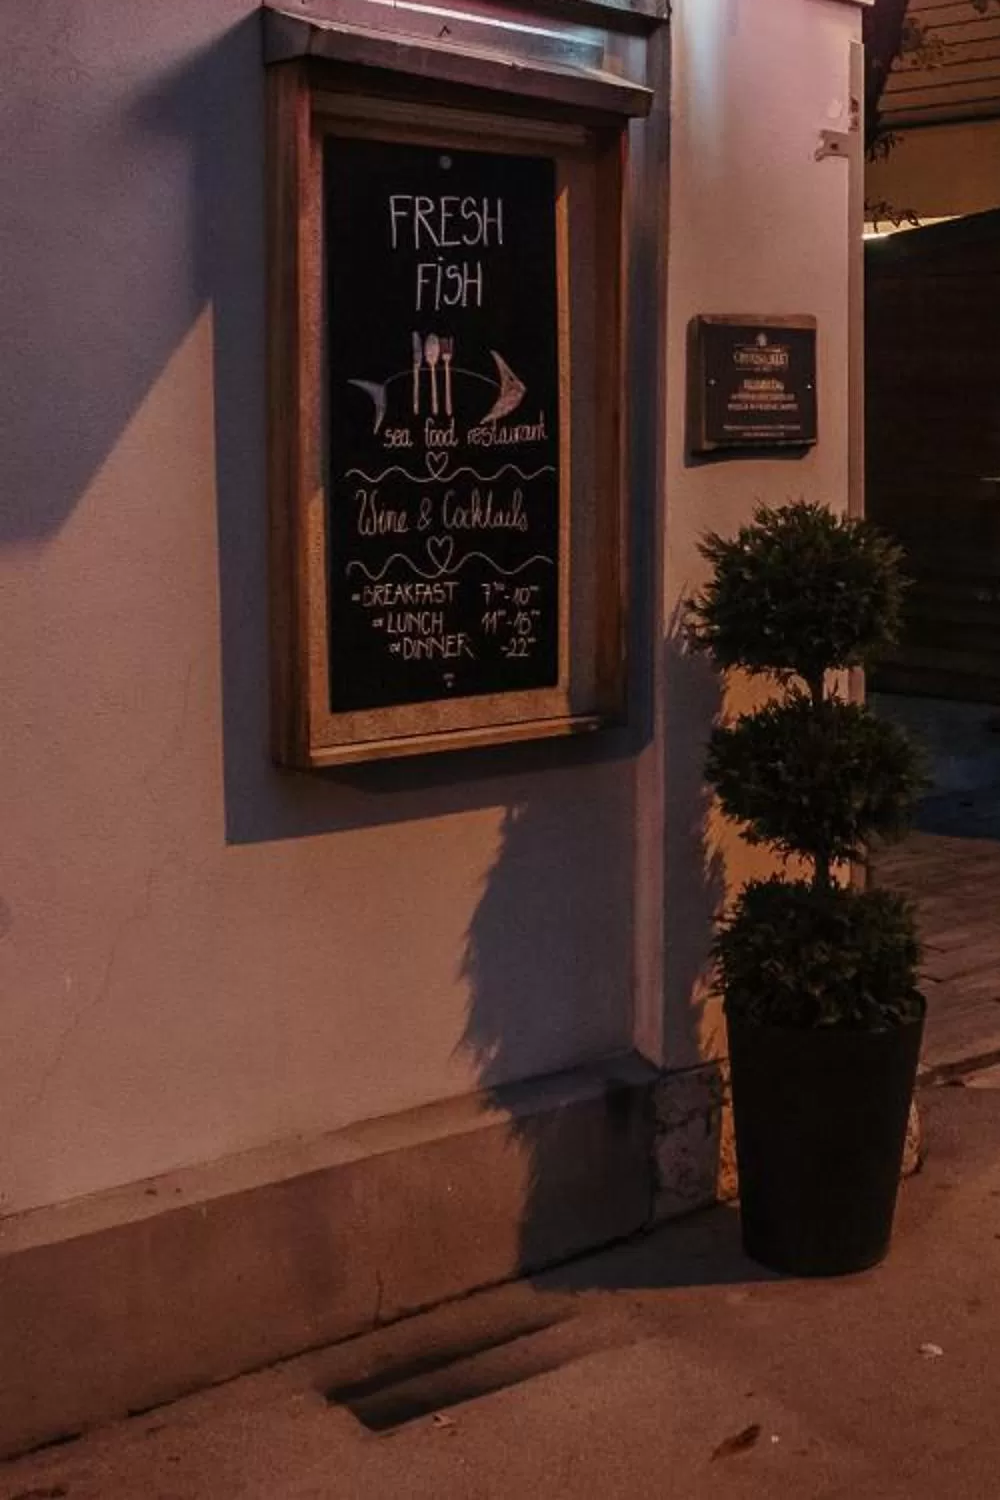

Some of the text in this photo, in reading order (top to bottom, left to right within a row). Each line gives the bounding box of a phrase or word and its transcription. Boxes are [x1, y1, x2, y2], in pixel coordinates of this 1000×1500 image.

[389, 195, 503, 250] FRESH
[383, 409, 549, 449] sea food restaurant
[355, 489, 410, 536] Wine
[416, 498, 433, 531] &
[362, 581, 460, 607] BREAKFAST
[387, 611, 444, 635] LUNCH
[403, 632, 476, 661] DINNER
